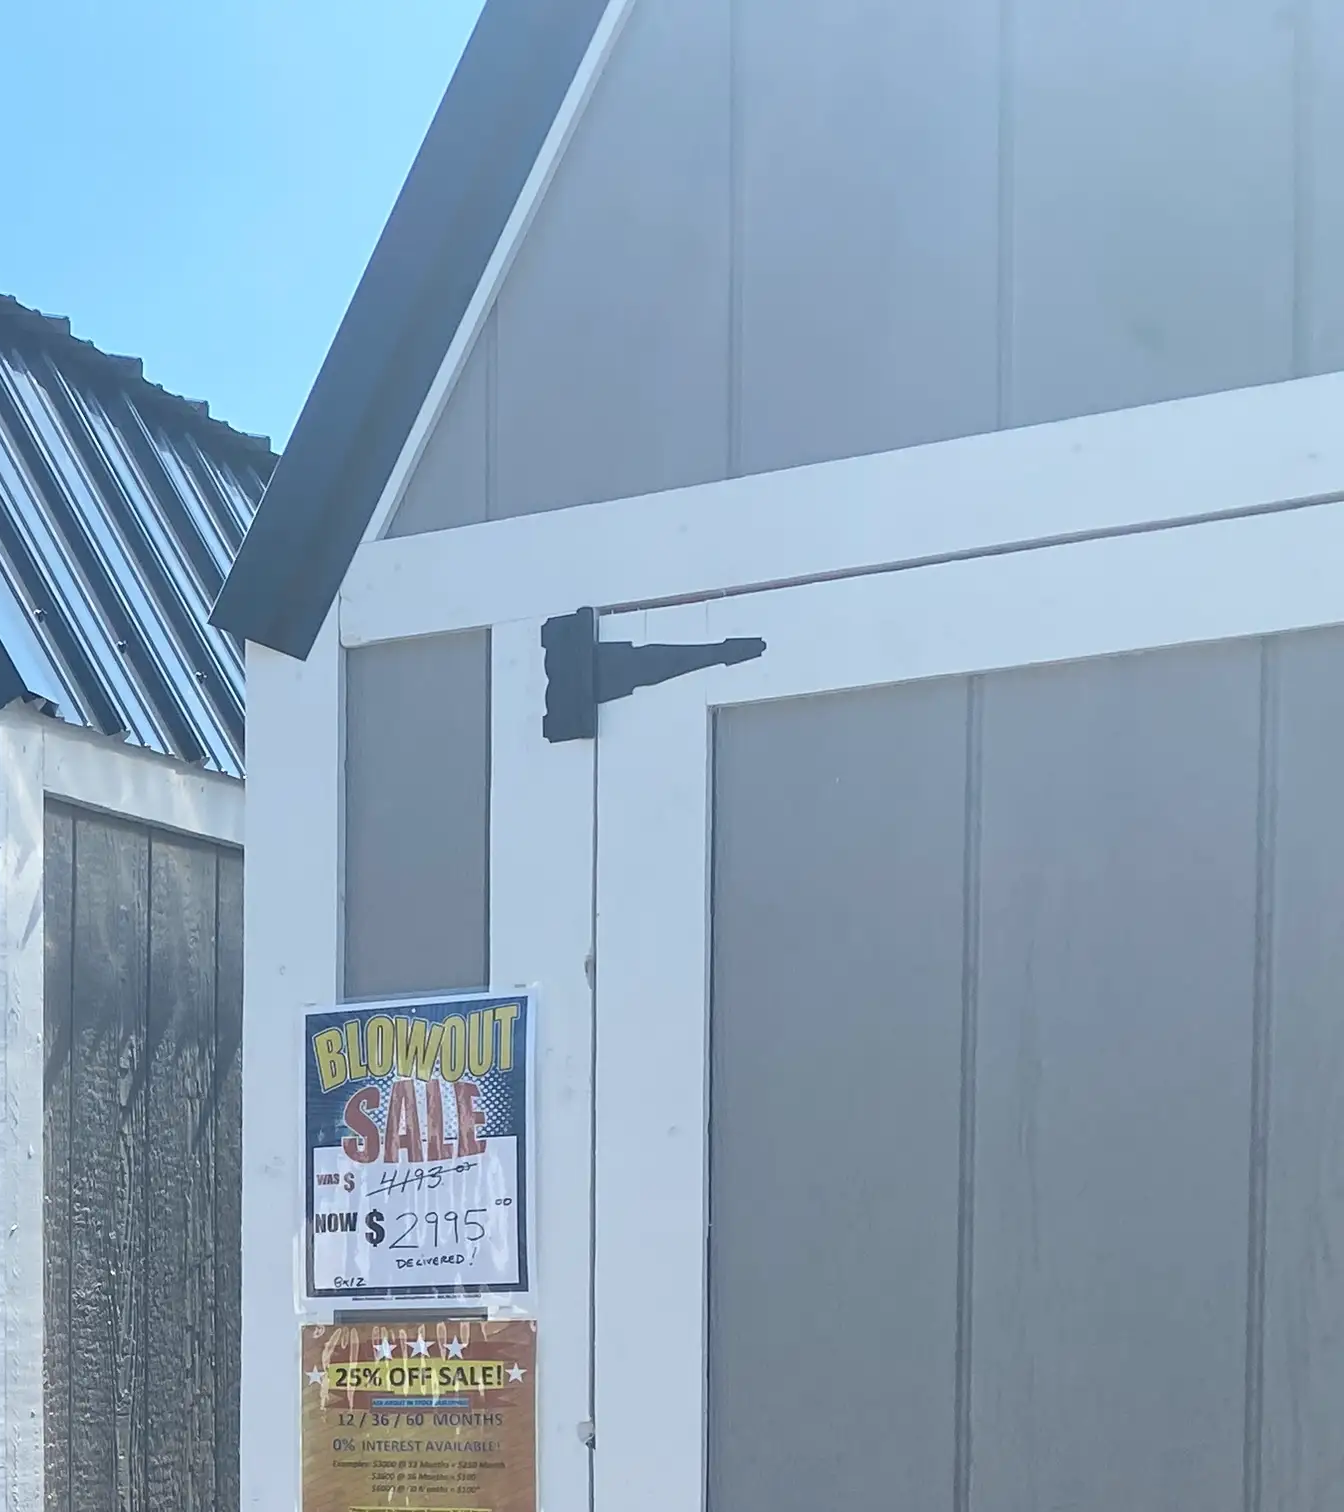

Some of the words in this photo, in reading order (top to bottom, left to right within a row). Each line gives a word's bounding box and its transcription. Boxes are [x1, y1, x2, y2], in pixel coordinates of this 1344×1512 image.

[312, 1002, 521, 1092] BLOWOUT
[341, 1078, 487, 1164] SALE
[317, 1174, 340, 1186] WAS
[344, 1173, 355, 1192] $
[315, 1212, 358, 1233] NOW
[365, 1209, 385, 1247] $
[389, 1209, 487, 1249] 2995
[335, 1368, 382, 1387] 25%
[390, 1367, 432, 1387] OFF
[438, 1366, 502, 1386] SALE!
[338, 1414, 354, 1426] 12
[372, 1414, 389, 1426] 36
[406, 1414, 424, 1426] 60
[433, 1414, 503, 1426] MONTHS
[333, 1439, 356, 1452] 0%
[362, 1441, 420, 1452] INTEREST
